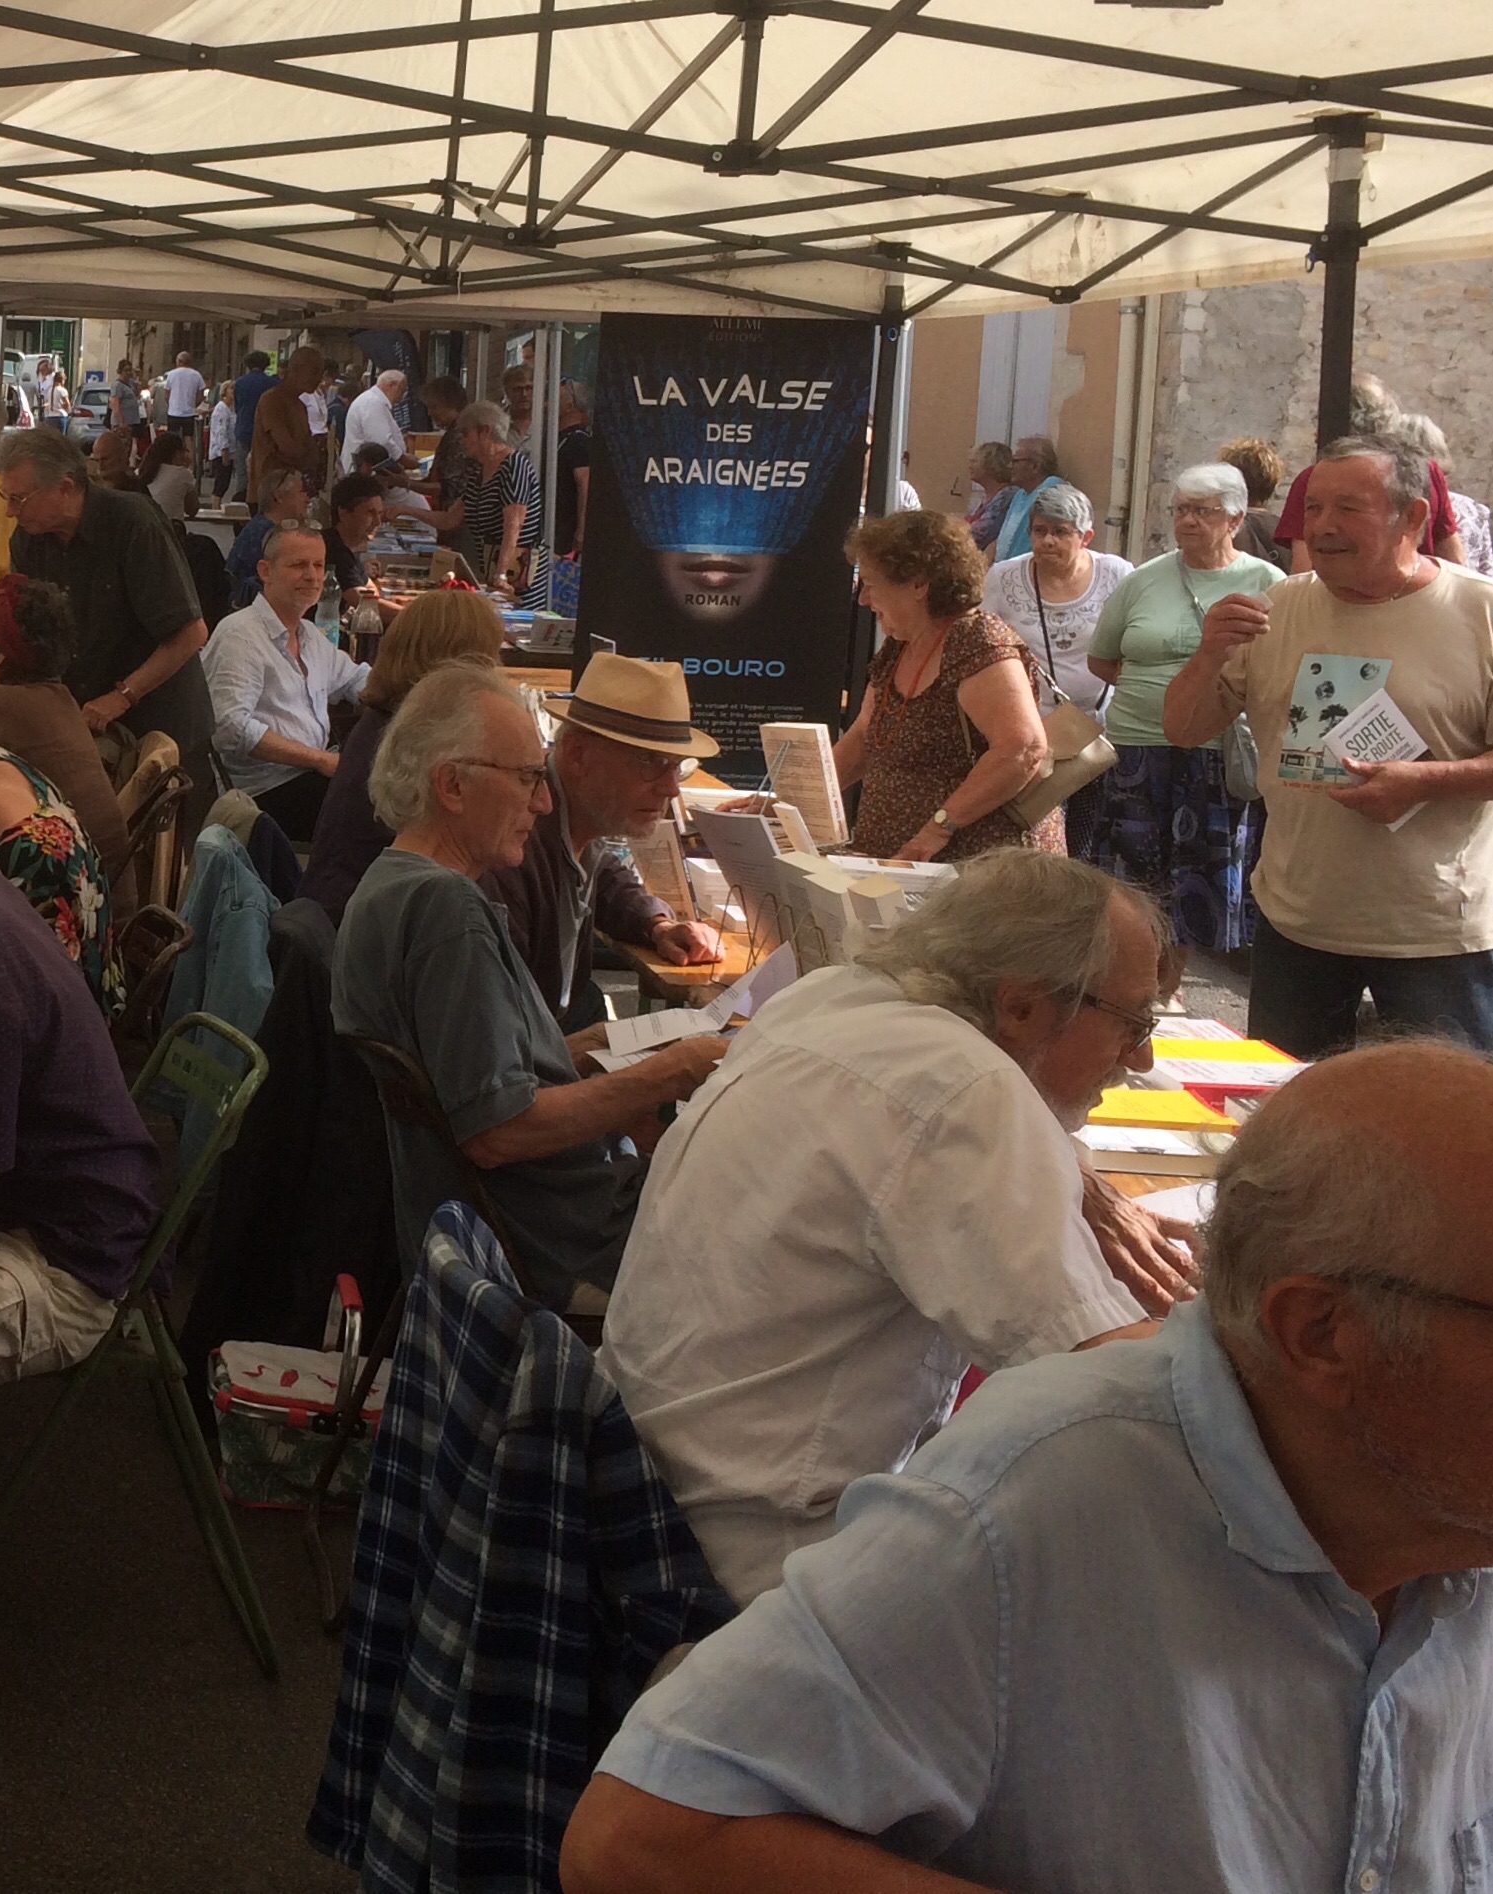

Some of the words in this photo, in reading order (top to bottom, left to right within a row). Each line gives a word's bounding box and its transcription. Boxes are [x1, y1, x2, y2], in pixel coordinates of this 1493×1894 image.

[633, 376, 688, 407] LA
[698, 373, 833, 411] VALSE
[706, 423, 753, 443] DES
[644, 456, 810, 491] ARAIGNÉES
[684, 593, 742, 607] ROMAN
[682, 657, 785, 678] BOURO
[1345, 710, 1395, 758] SORTIE
[1370, 727, 1406, 762] ROUTE
